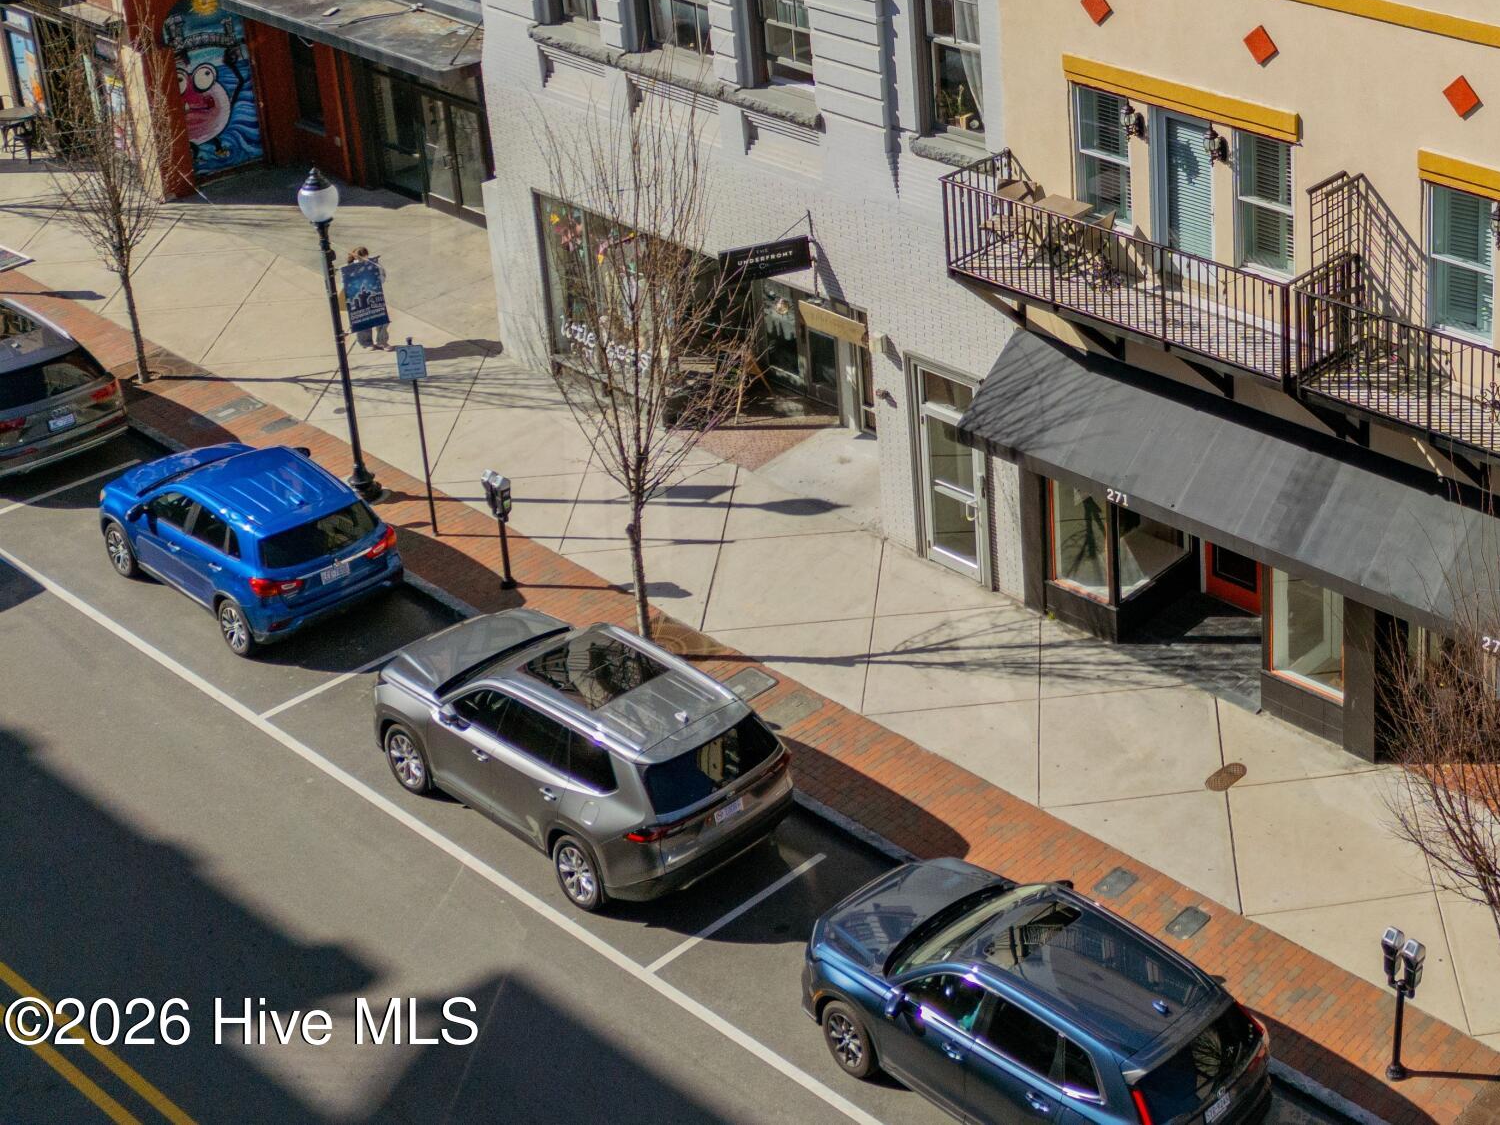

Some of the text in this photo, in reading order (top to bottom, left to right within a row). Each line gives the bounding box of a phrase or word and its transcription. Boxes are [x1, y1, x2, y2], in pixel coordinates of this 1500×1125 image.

[737, 250, 794, 266] UNDERFRONT
[400, 349, 409, 366] 2
[1106, 488, 1129, 507] 271
